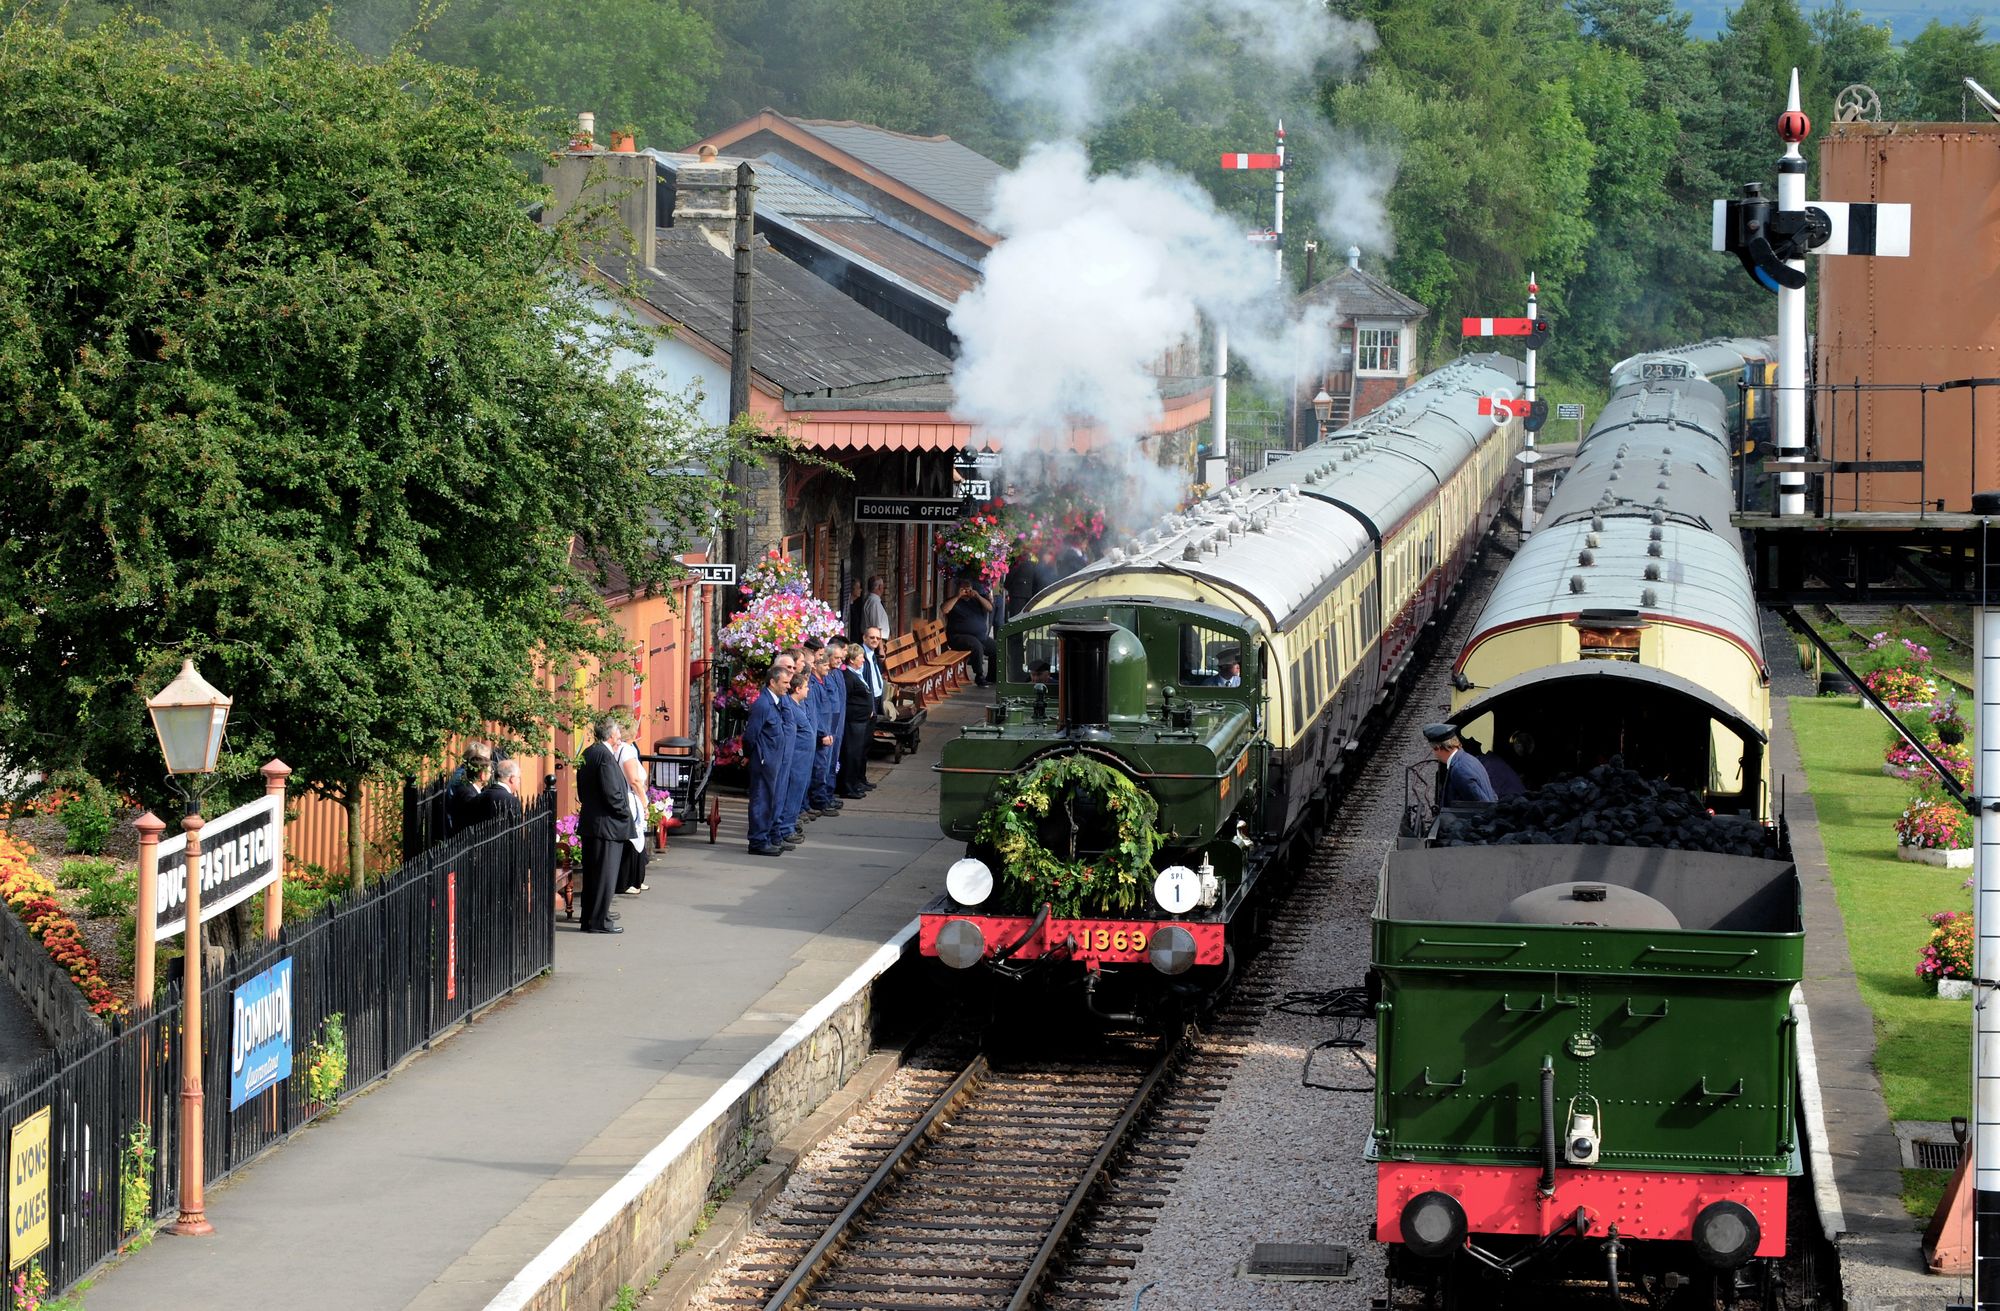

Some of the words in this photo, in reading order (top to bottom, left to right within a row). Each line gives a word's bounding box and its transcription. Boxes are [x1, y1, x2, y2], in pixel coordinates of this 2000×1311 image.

[1644, 364, 1685, 378] 2837
[863, 505, 910, 515] BOOKING
[688, 568, 732, 580] ILET
[157, 822, 273, 914] BUCFASTLEIGH
[1174, 884, 1180, 903] 1
[1084, 928, 1148, 951] 1369
[233, 968, 291, 1073] DOMINION
[16, 1137, 47, 1186] LYONS
[15, 1188, 47, 1237] CAKES
